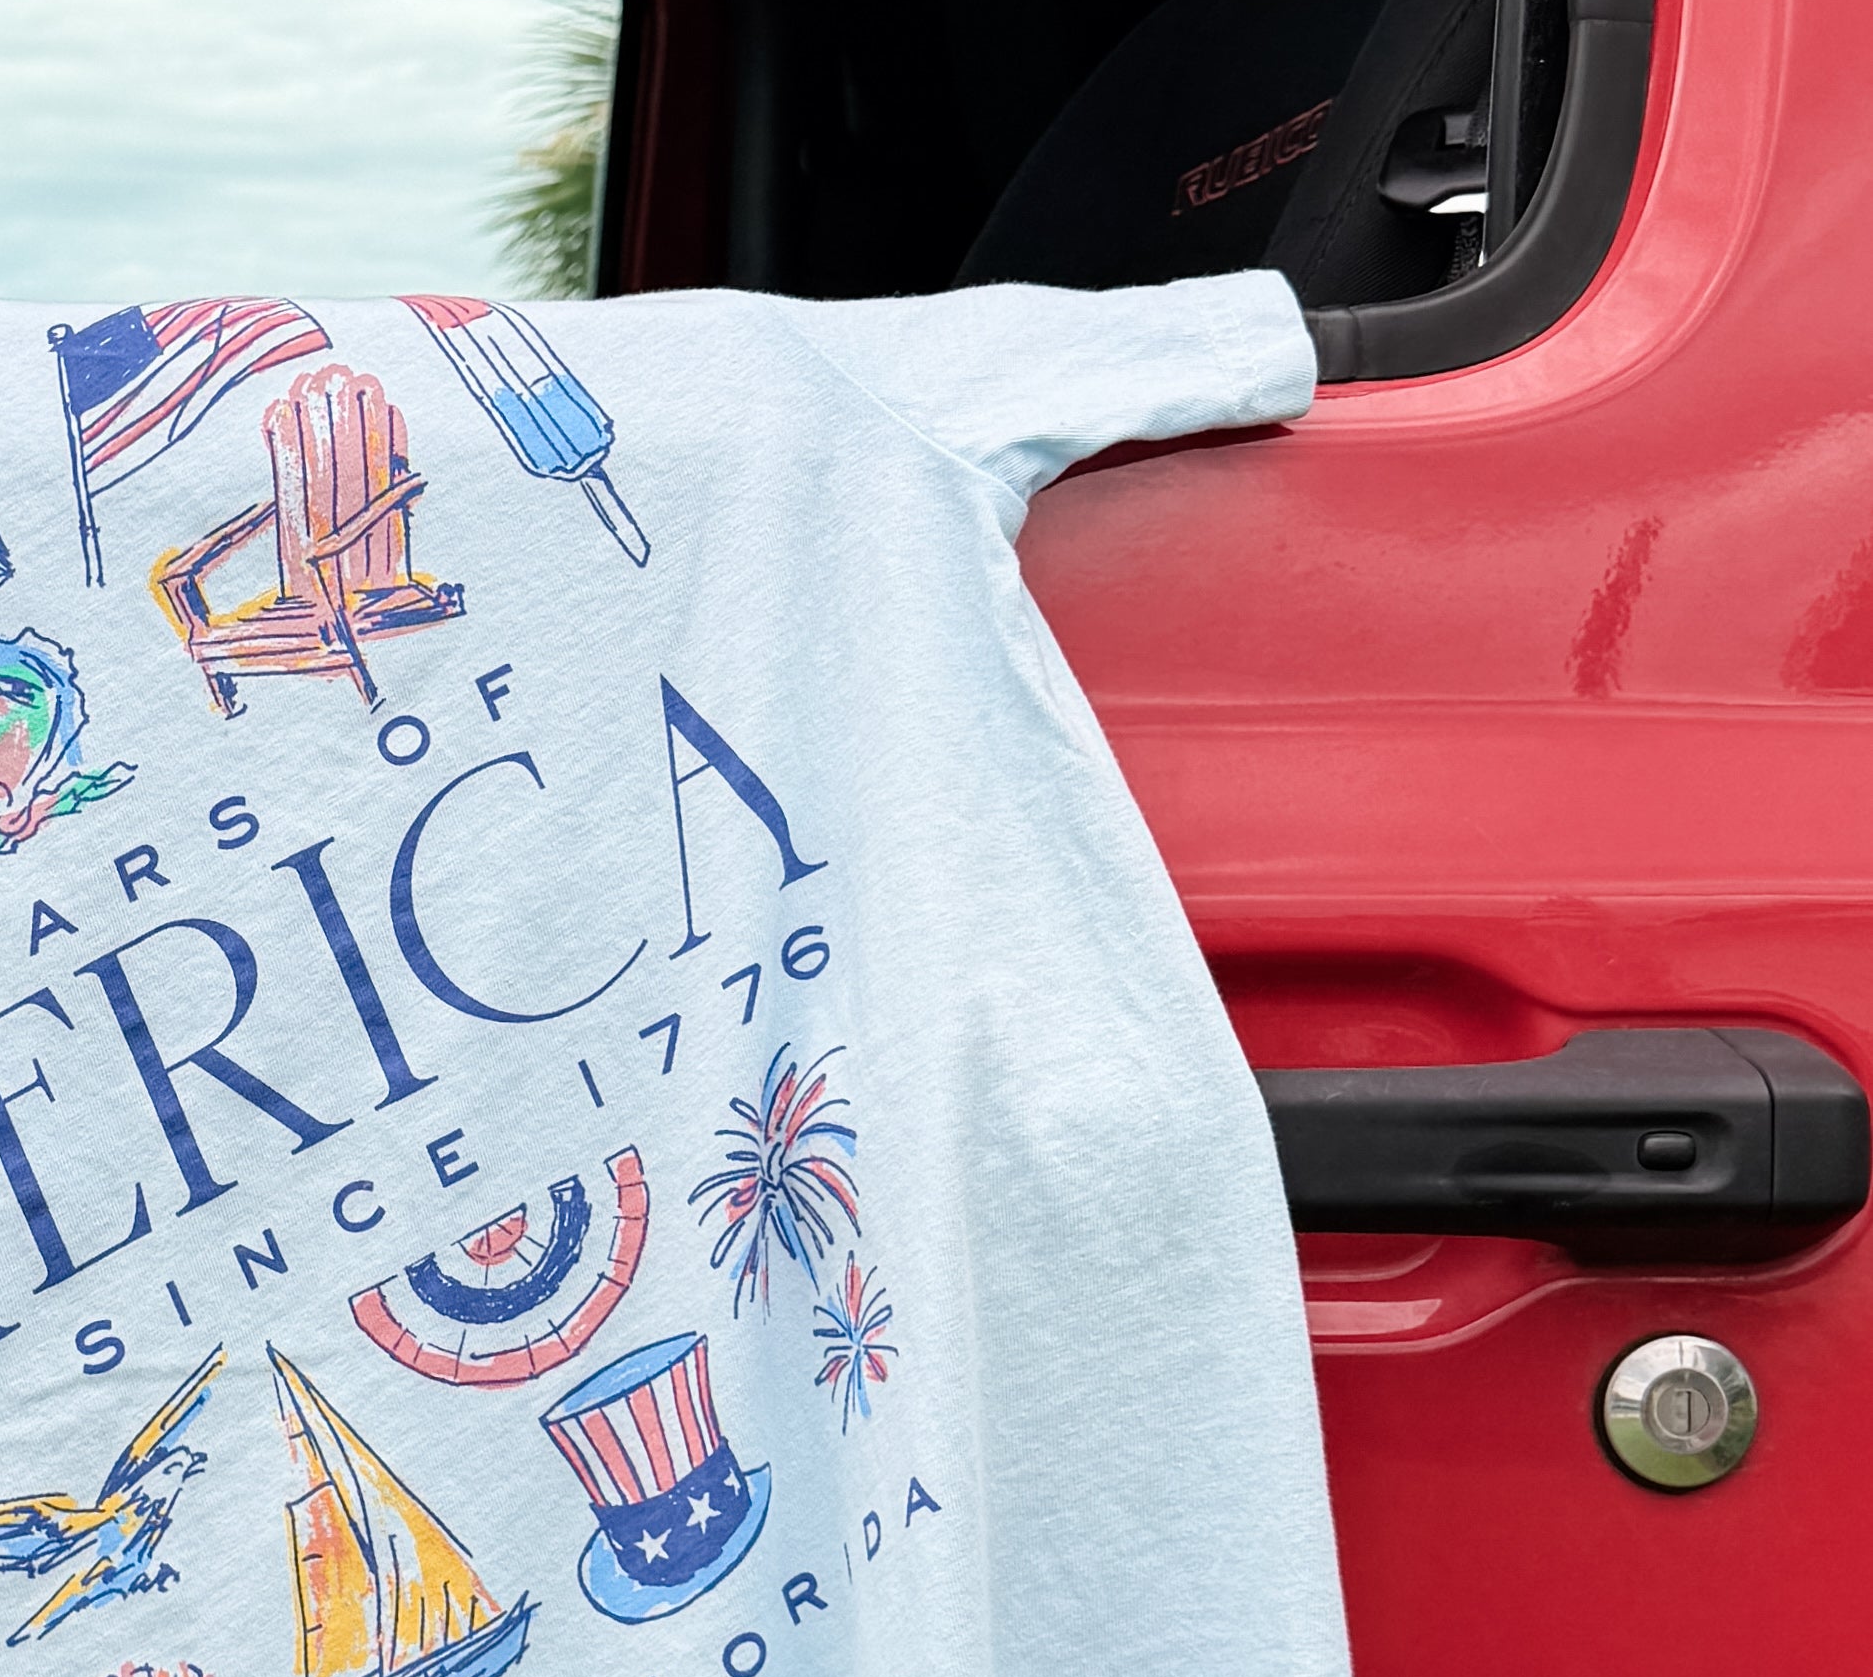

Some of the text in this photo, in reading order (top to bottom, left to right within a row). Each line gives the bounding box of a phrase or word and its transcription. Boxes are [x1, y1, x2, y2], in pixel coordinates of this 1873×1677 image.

[375, 662, 516, 768] OF
[73, 924, 832, 1377] SINCE 1776
